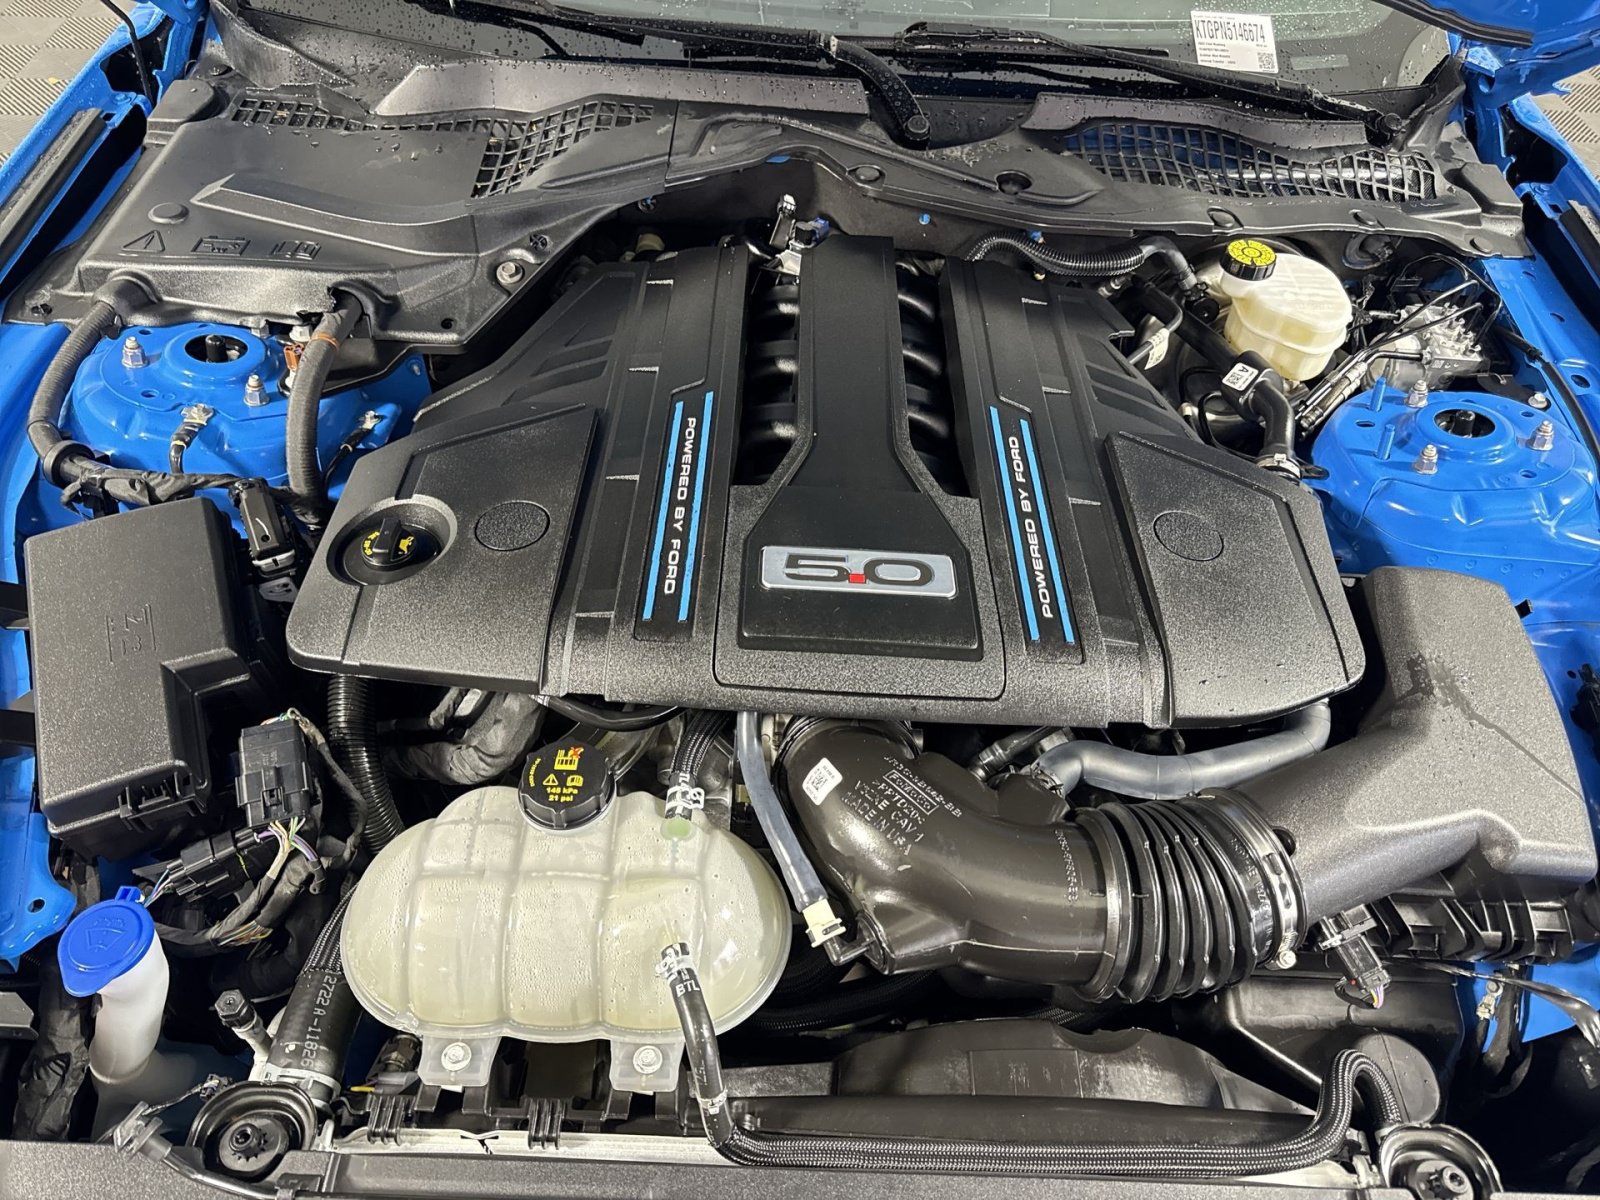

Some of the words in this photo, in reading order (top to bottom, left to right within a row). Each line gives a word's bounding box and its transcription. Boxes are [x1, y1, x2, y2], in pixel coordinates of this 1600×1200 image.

[1195, 20, 1266, 43] KTGPN5146674
[677, 417, 697, 501] POWERED
[1009, 436, 1026, 483] FORD
[1018, 488, 1032, 513] BY
[673, 506, 686, 532] BY
[664, 539, 681, 594] FORD
[784, 552, 935, 587] 5.0
[1025, 519, 1053, 618] POWERED
[675, 980, 701, 998] BTL
